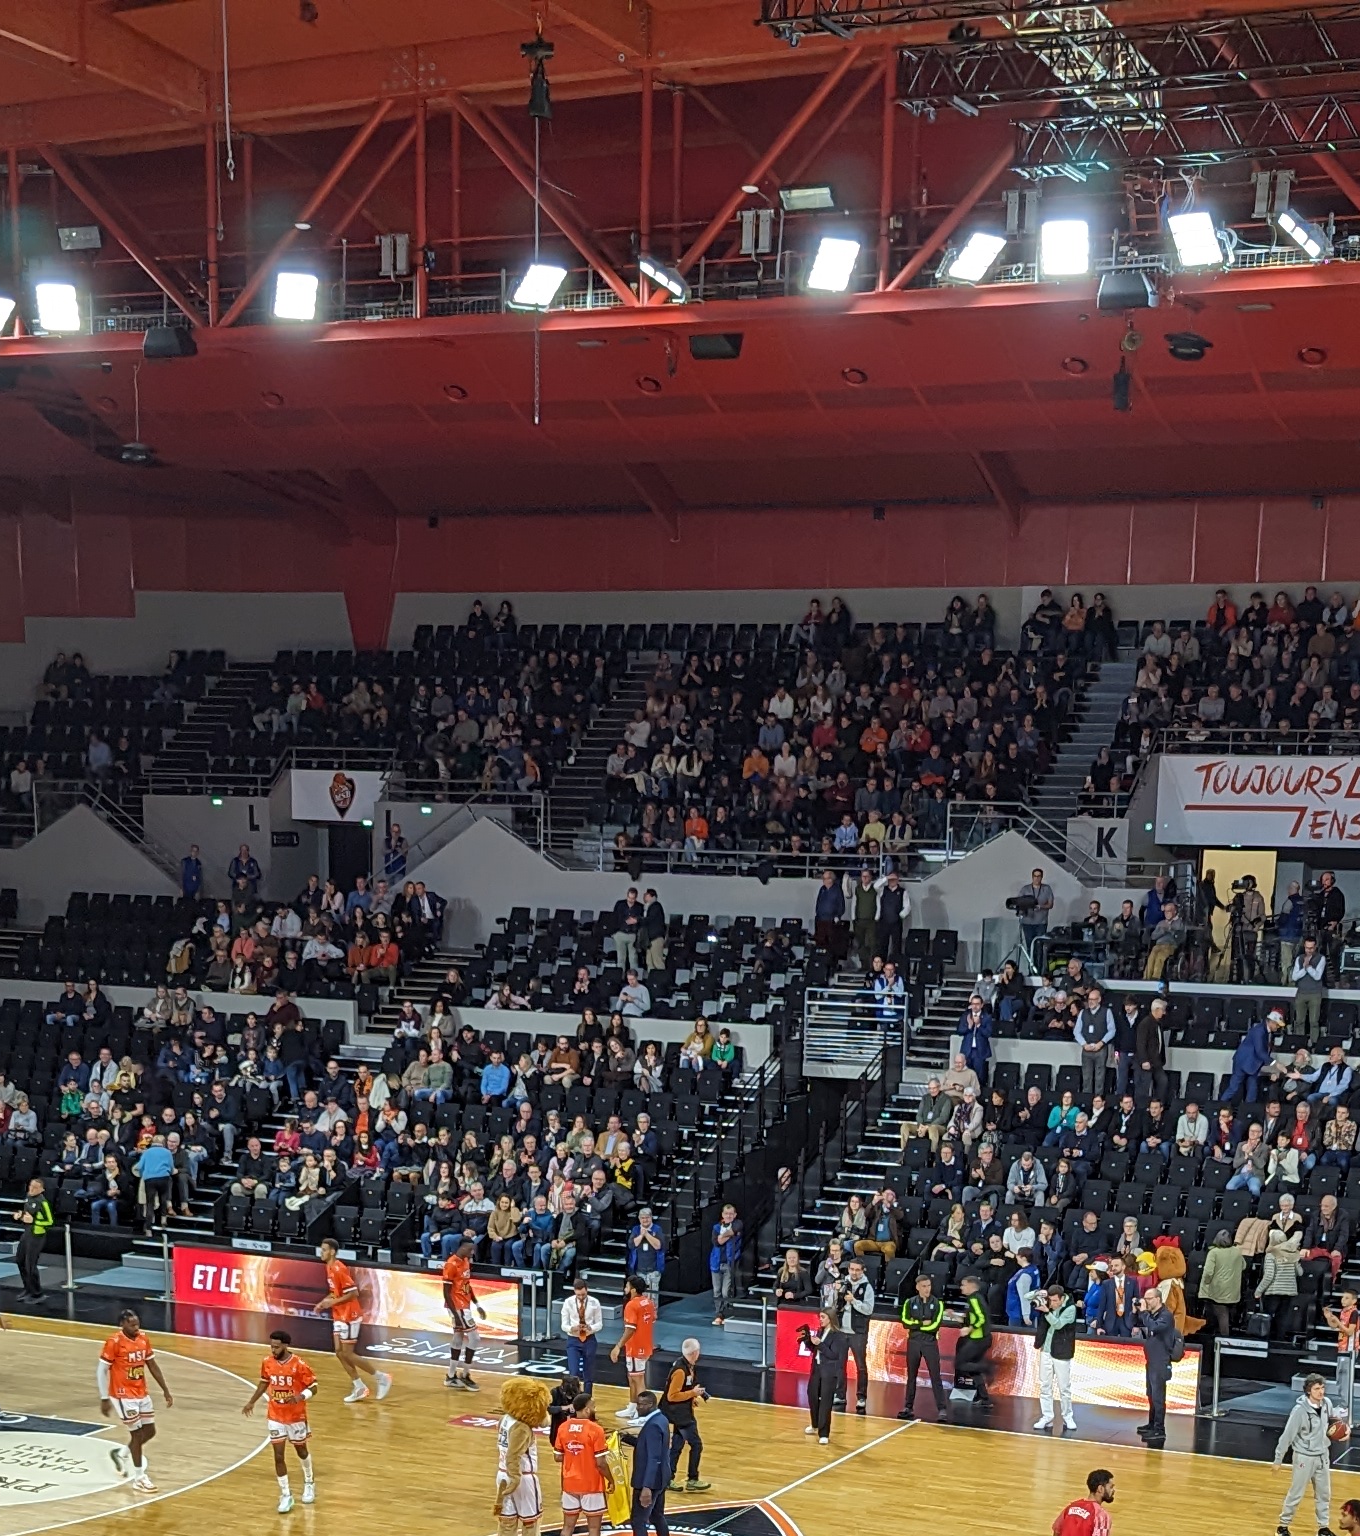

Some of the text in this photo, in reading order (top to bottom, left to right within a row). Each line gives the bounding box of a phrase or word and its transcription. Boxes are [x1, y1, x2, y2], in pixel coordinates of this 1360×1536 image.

[1195, 760, 1348, 803] TOUJOURS
[248, 804, 260, 832] L
[1096, 826, 1118, 858] K
[192, 1263, 242, 1293] ET LE
[270, 1375, 293, 1386] MSB
[13, 1442, 68, 1455] 1931
